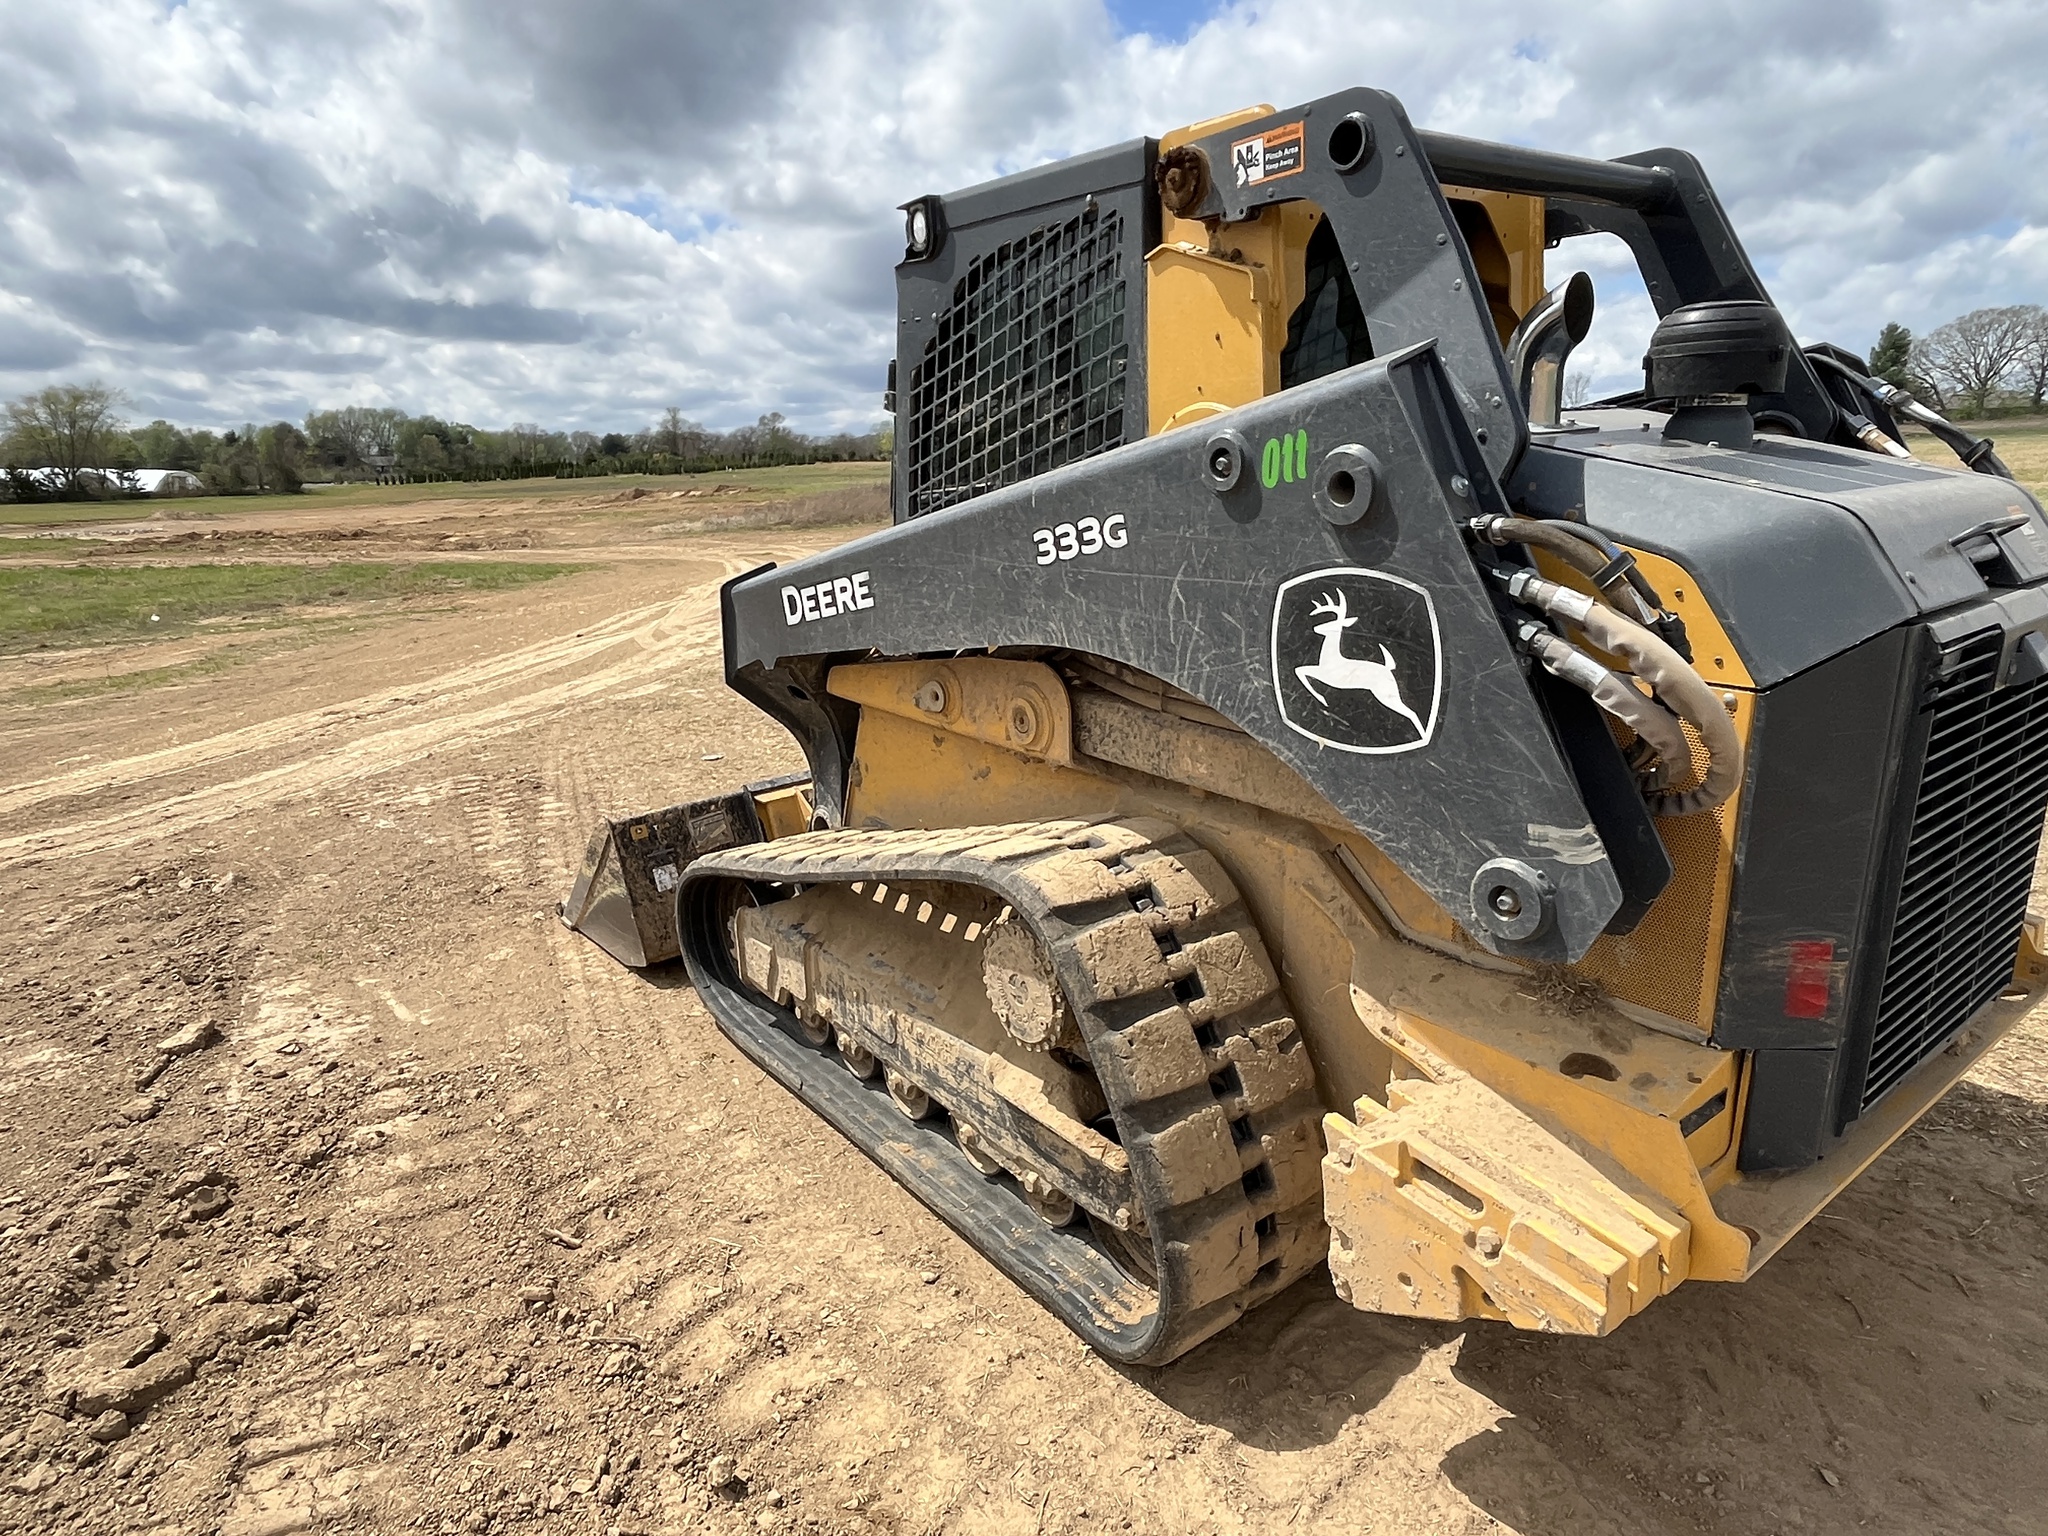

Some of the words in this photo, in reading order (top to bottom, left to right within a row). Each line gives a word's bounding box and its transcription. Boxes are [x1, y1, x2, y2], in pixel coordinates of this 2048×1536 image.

[1265, 150, 1283, 162] Pinch
[1284, 146, 1299, 156] Area
[1265, 162, 1279, 171] Keep
[1279, 158, 1295, 167] Away
[1261, 429, 1308, 489] 011
[1033, 514, 1129, 566] 333G
[780, 571, 875, 626] DEERE
